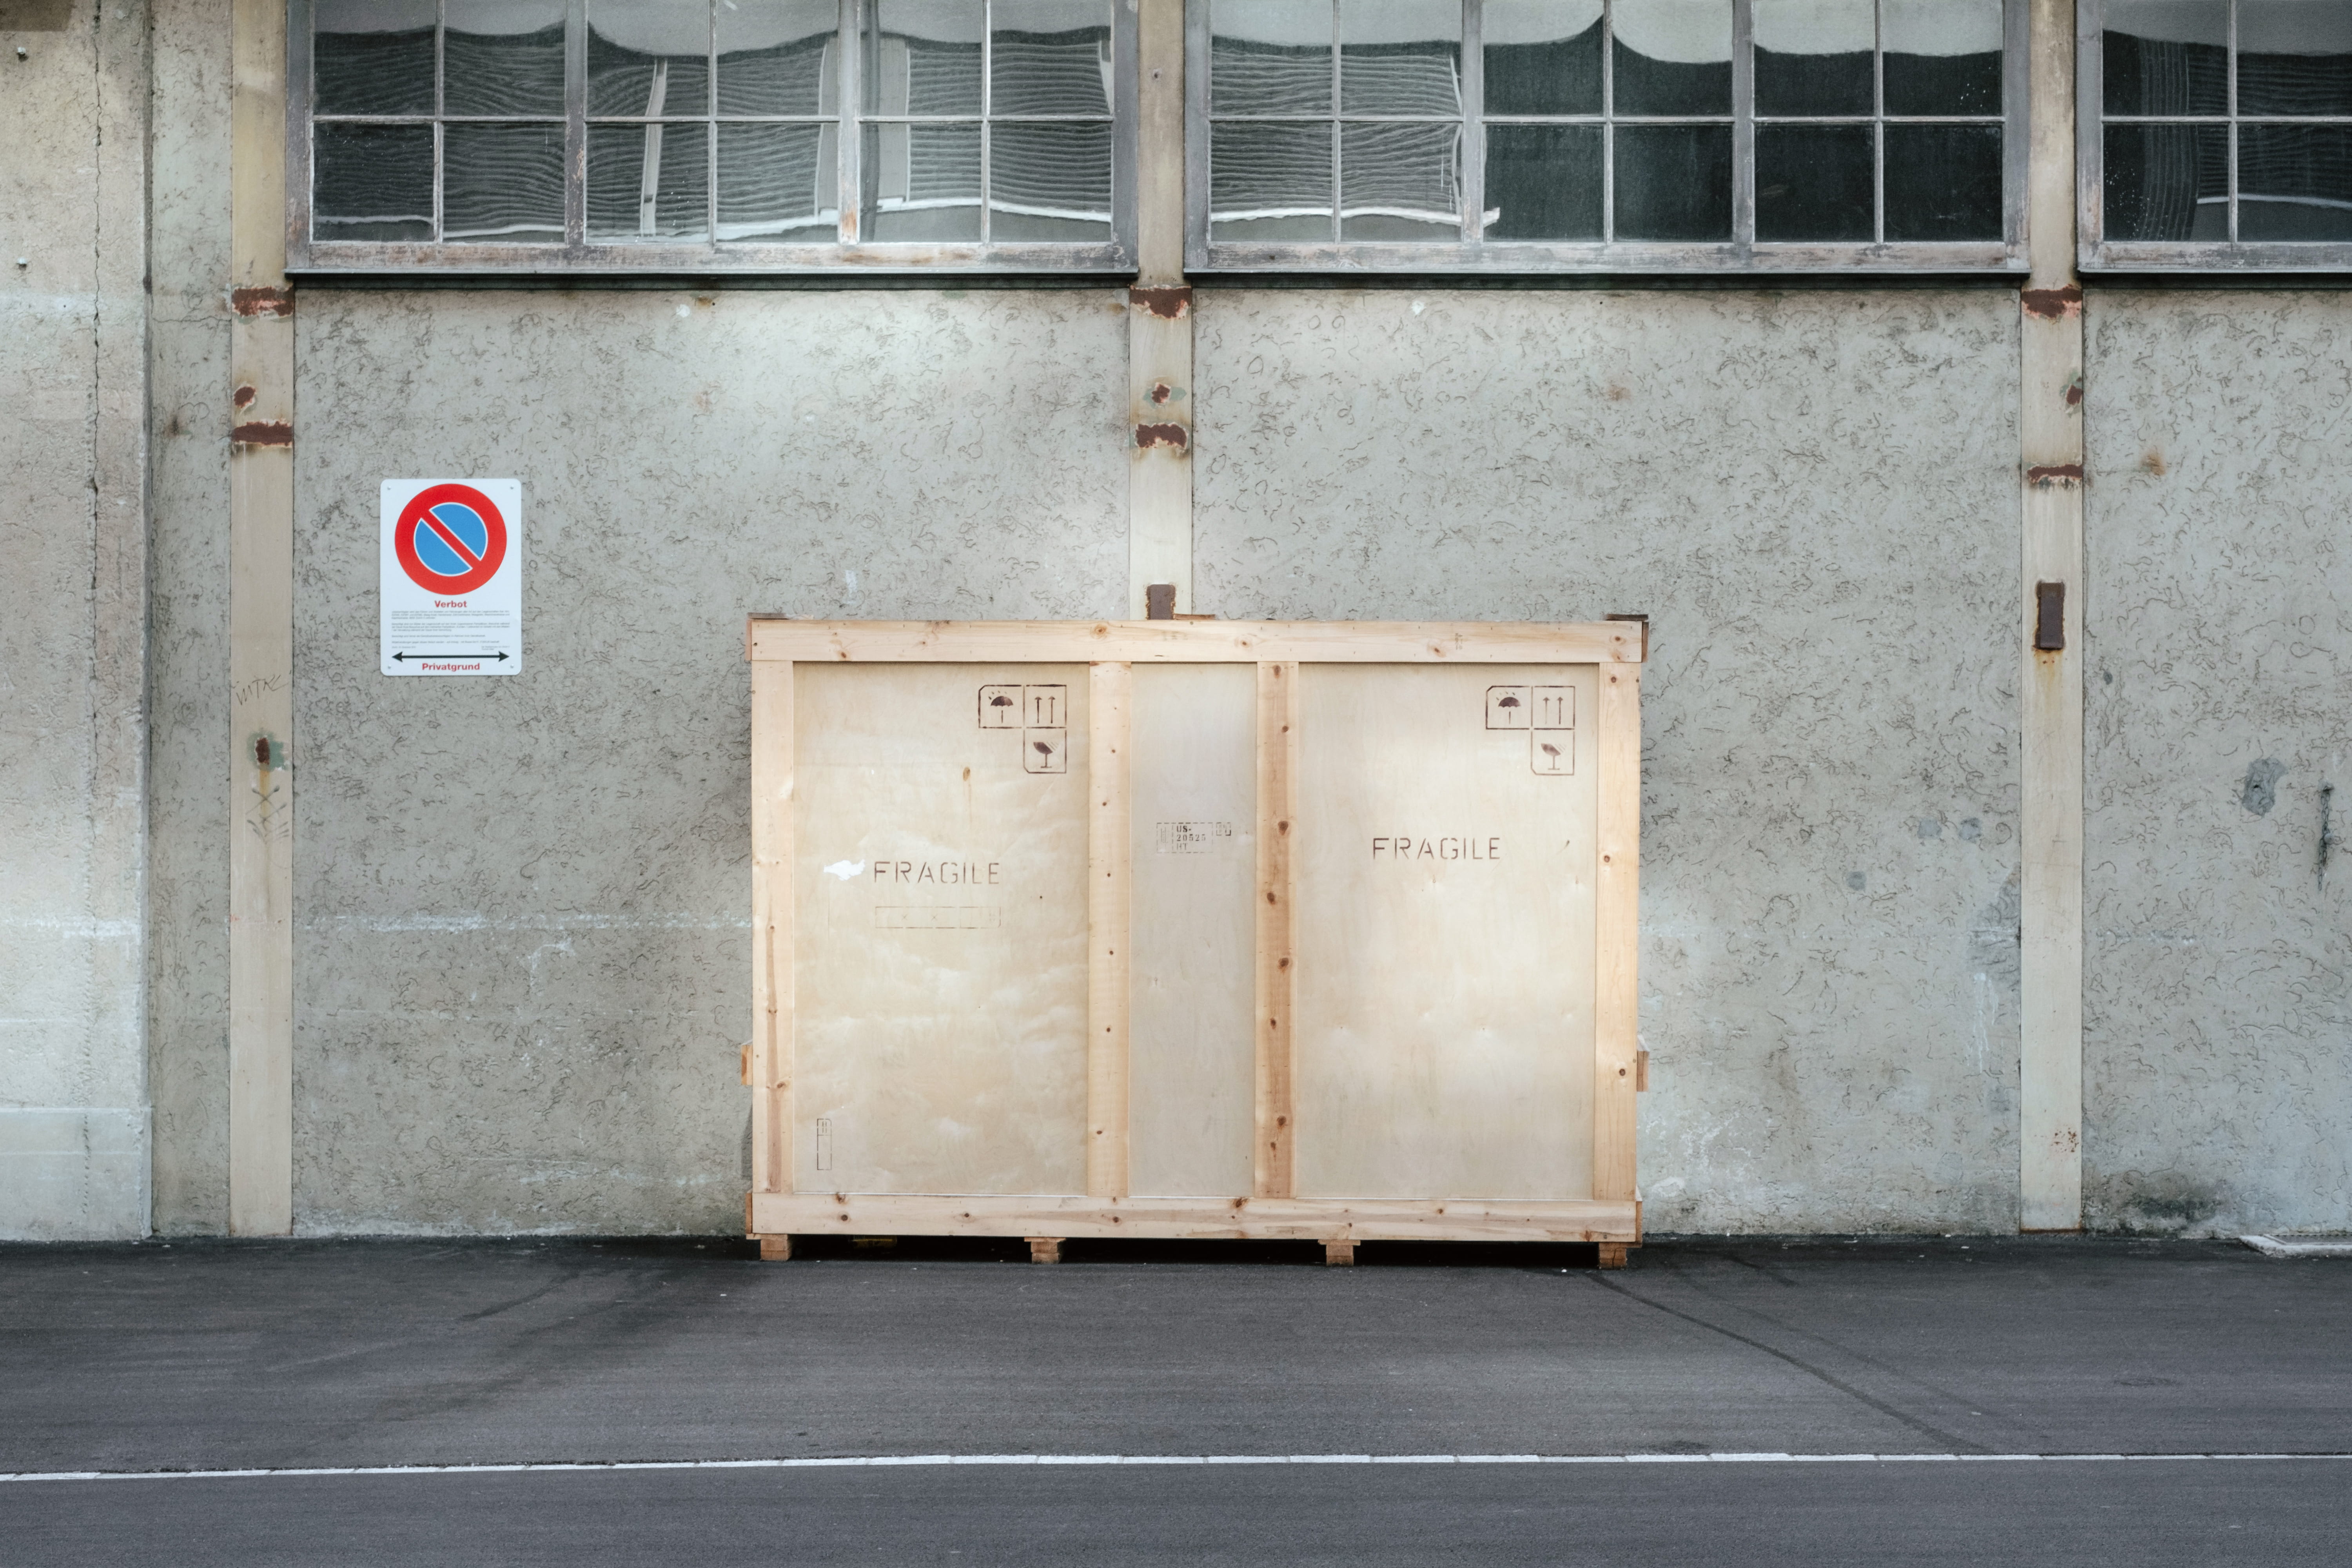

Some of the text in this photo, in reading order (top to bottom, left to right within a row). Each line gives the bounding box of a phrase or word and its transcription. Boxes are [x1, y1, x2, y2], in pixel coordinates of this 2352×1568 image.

[422, 662, 480, 672] Privatgrund
[1373, 837, 1501, 860] FRAGILE
[874, 861, 1000, 884] FRAGILE
